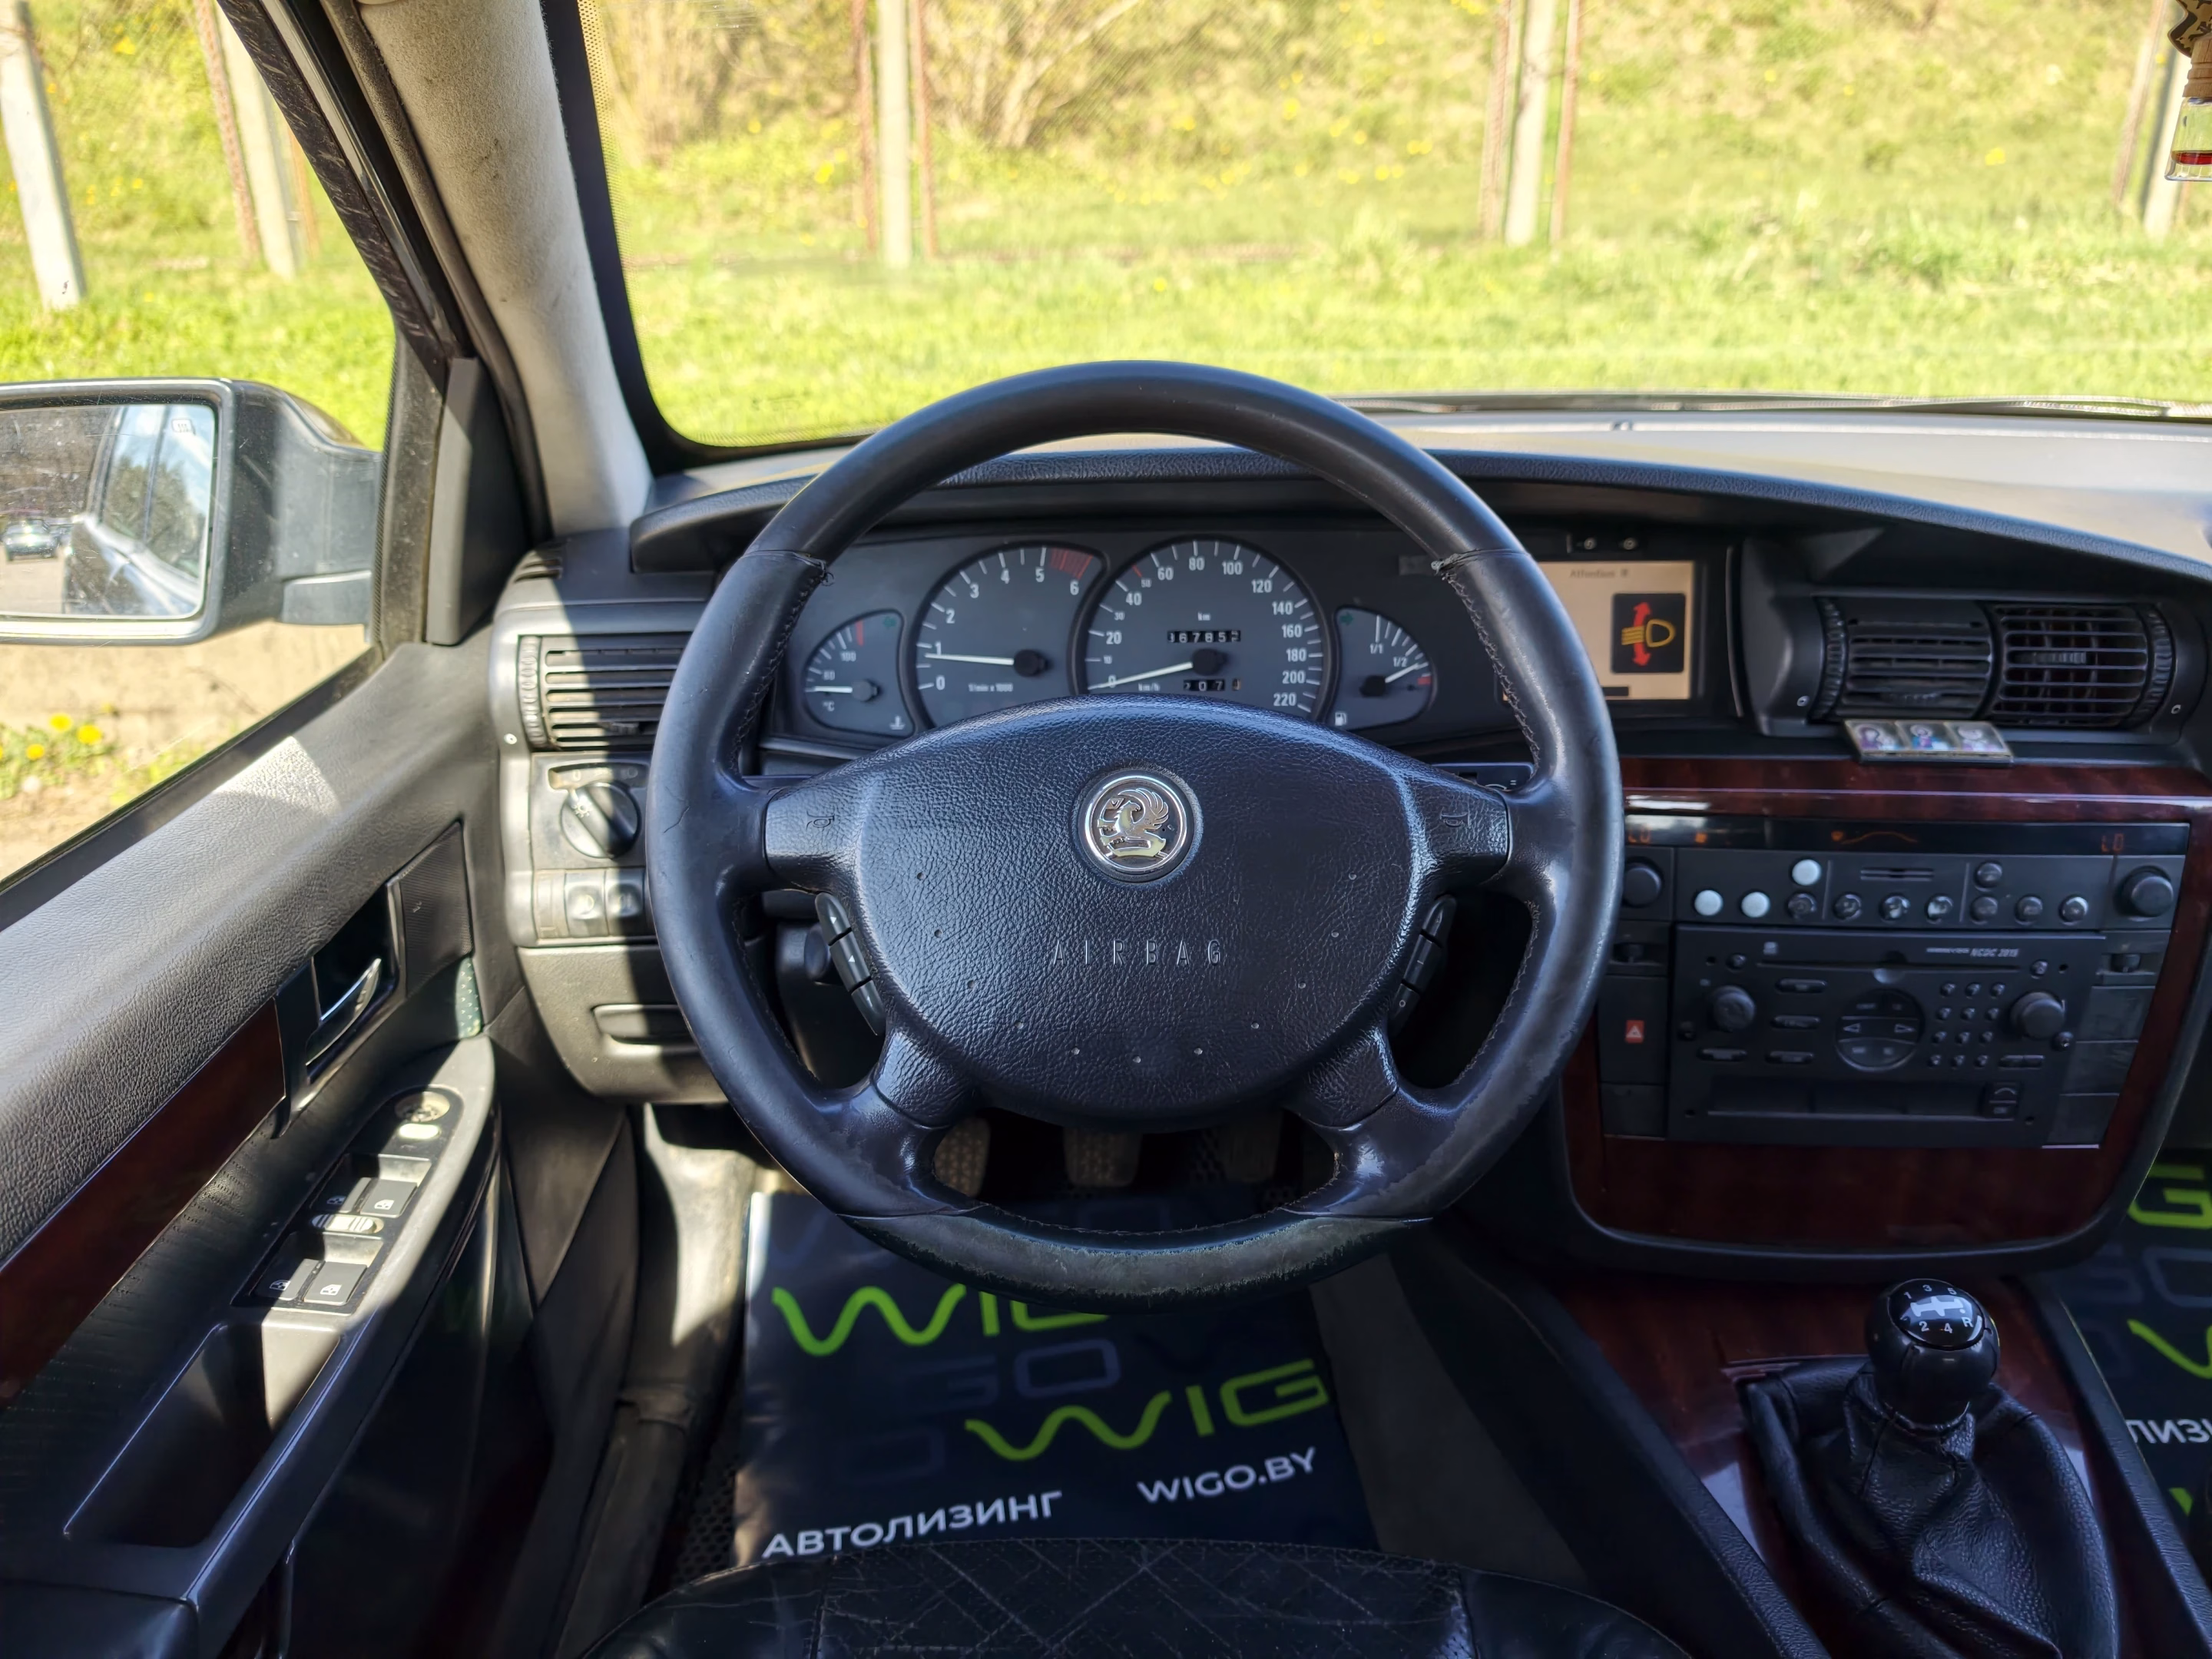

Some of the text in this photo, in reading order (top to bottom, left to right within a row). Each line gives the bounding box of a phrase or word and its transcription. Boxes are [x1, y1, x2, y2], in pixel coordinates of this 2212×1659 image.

[1188, 557, 1205, 571] 80
[1222, 561, 1243, 575] 100
[1000, 568, 1010, 584] 4
[1035, 568, 1045, 583] 5
[1157, 566, 1174, 581] 60
[1069, 580, 1080, 596] 6
[1141, 578, 1152, 588] 50
[1251, 579, 1273, 594] 120
[969, 583, 980, 599] 3
[1125, 591, 1143, 606] 40
[1272, 601, 1293, 615] 140
[945, 608, 955, 624] 2
[1114, 611, 1125, 621] 30
[1197, 611, 1211, 621] km
[1105, 631, 1123, 645] 20
[1282, 624, 1303, 638] 160
[1286, 648, 1307, 662] 180
[935, 675, 945, 690] 0
[1282, 671, 1306, 684] 200
[1273, 693, 1297, 707] 220
[1052, 939, 1222, 966] AIRBAG
[1903, 1291, 1912, 1300] 1
[1947, 1287, 1958, 1296] 5
[1919, 1320, 1930, 1332] 2
[1943, 1323, 1954, 1334] 4
[1960, 1316, 1974, 1328] R
[1137, 1445, 1316, 1504] WIGO.BY
[761, 1490, 1063, 1559] АВТОЛИЗИНГ
